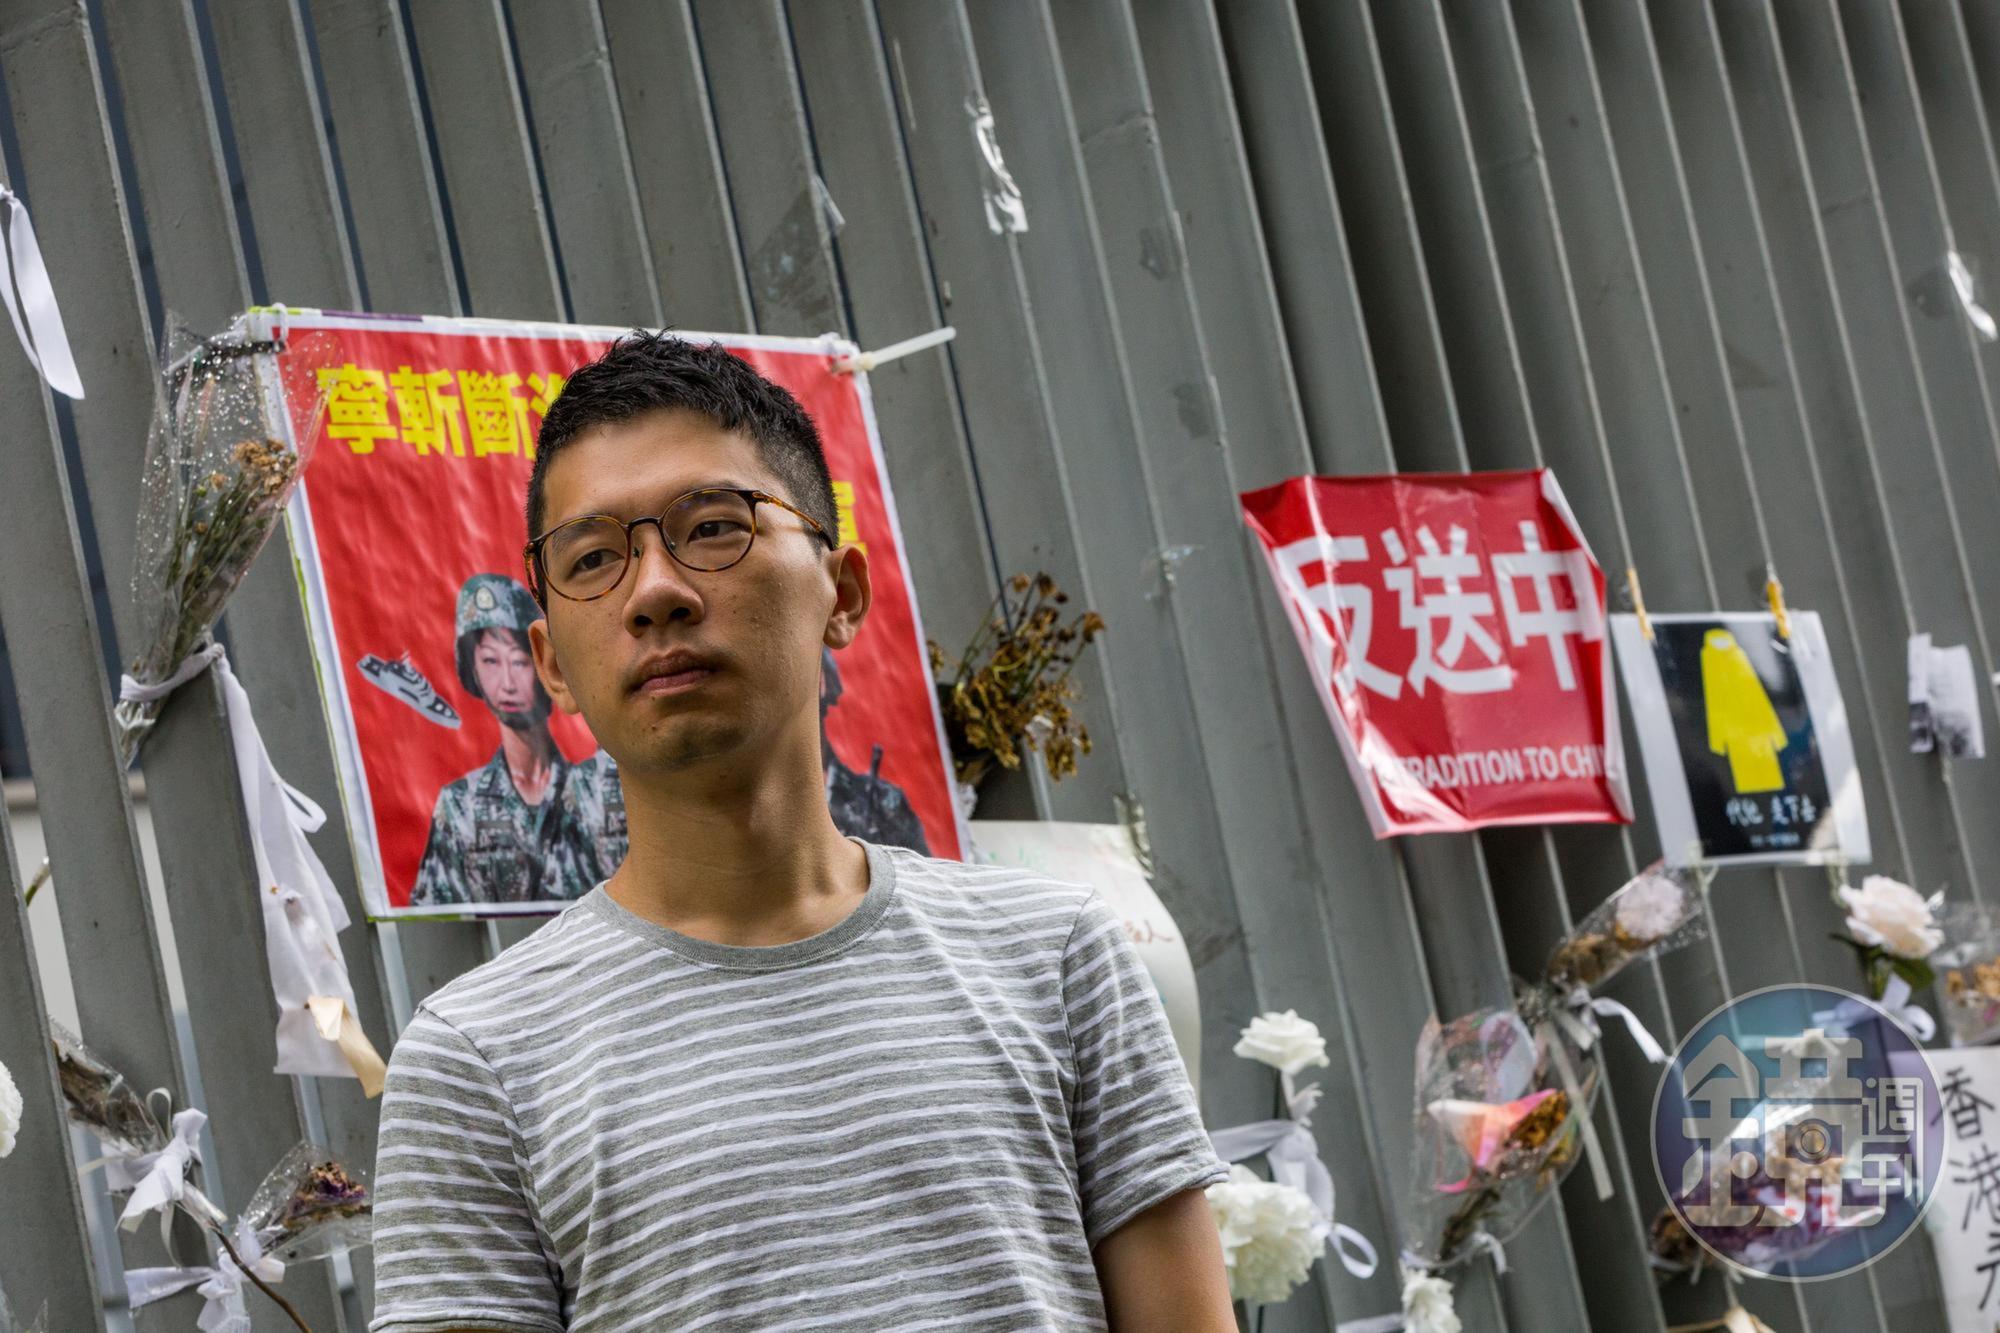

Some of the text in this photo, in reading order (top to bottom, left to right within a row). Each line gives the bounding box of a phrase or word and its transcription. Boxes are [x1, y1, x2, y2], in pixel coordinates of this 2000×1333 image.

[1273, 520, 1603, 700] 反送中
[1523, 746, 1560, 782] TO
[1561, 743, 1605, 780] CHI
